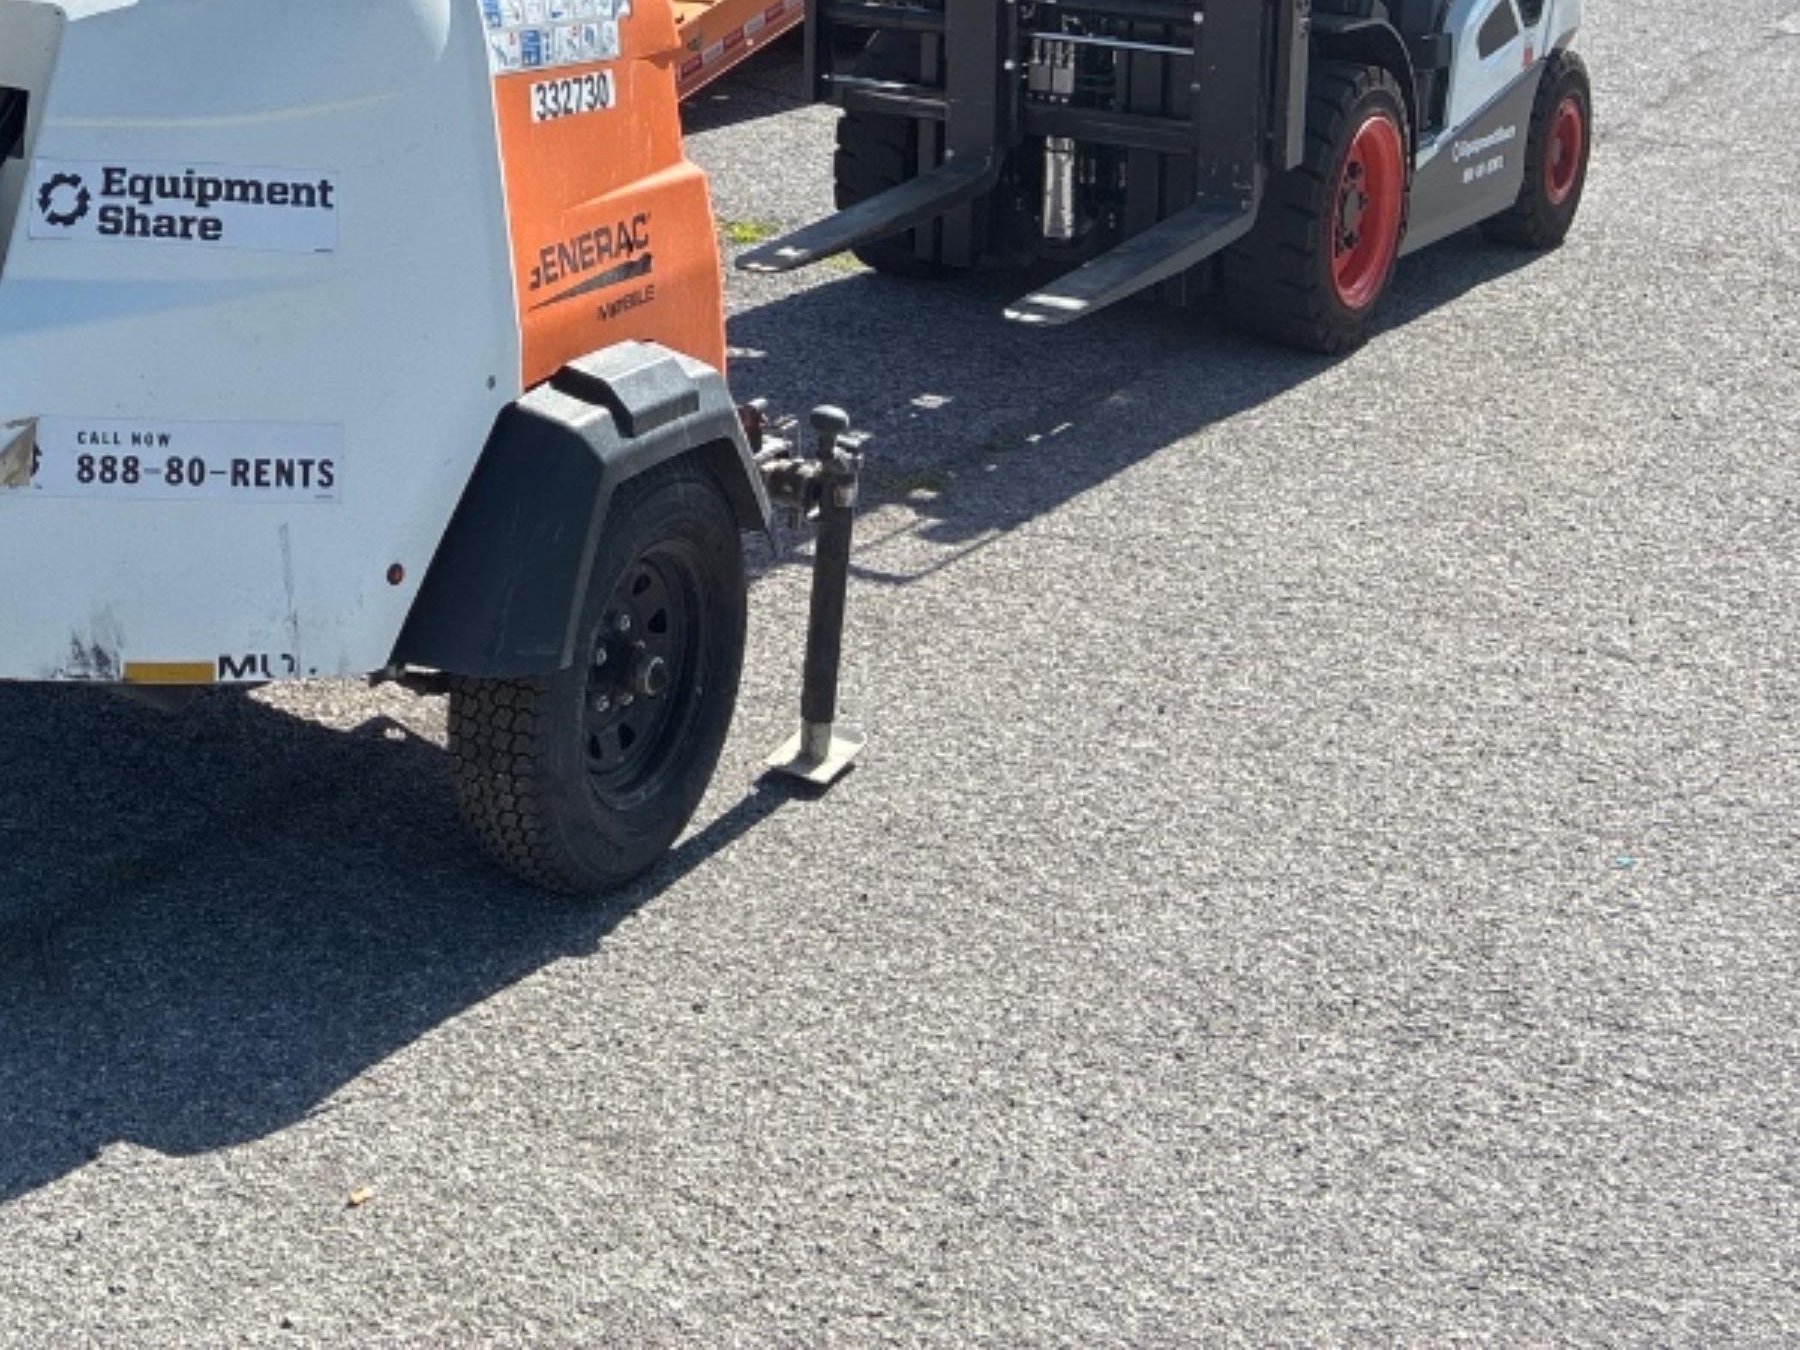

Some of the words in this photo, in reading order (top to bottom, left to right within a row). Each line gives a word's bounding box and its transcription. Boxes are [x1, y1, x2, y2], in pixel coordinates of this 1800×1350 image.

[535, 72, 610, 121] 332730
[101, 166, 334, 208] Equipment
[97, 203, 224, 241] Share
[77, 431, 121, 446] CALL
[131, 432, 172, 448] NOW
[76, 453, 335, 488] 888-80-RENTS
